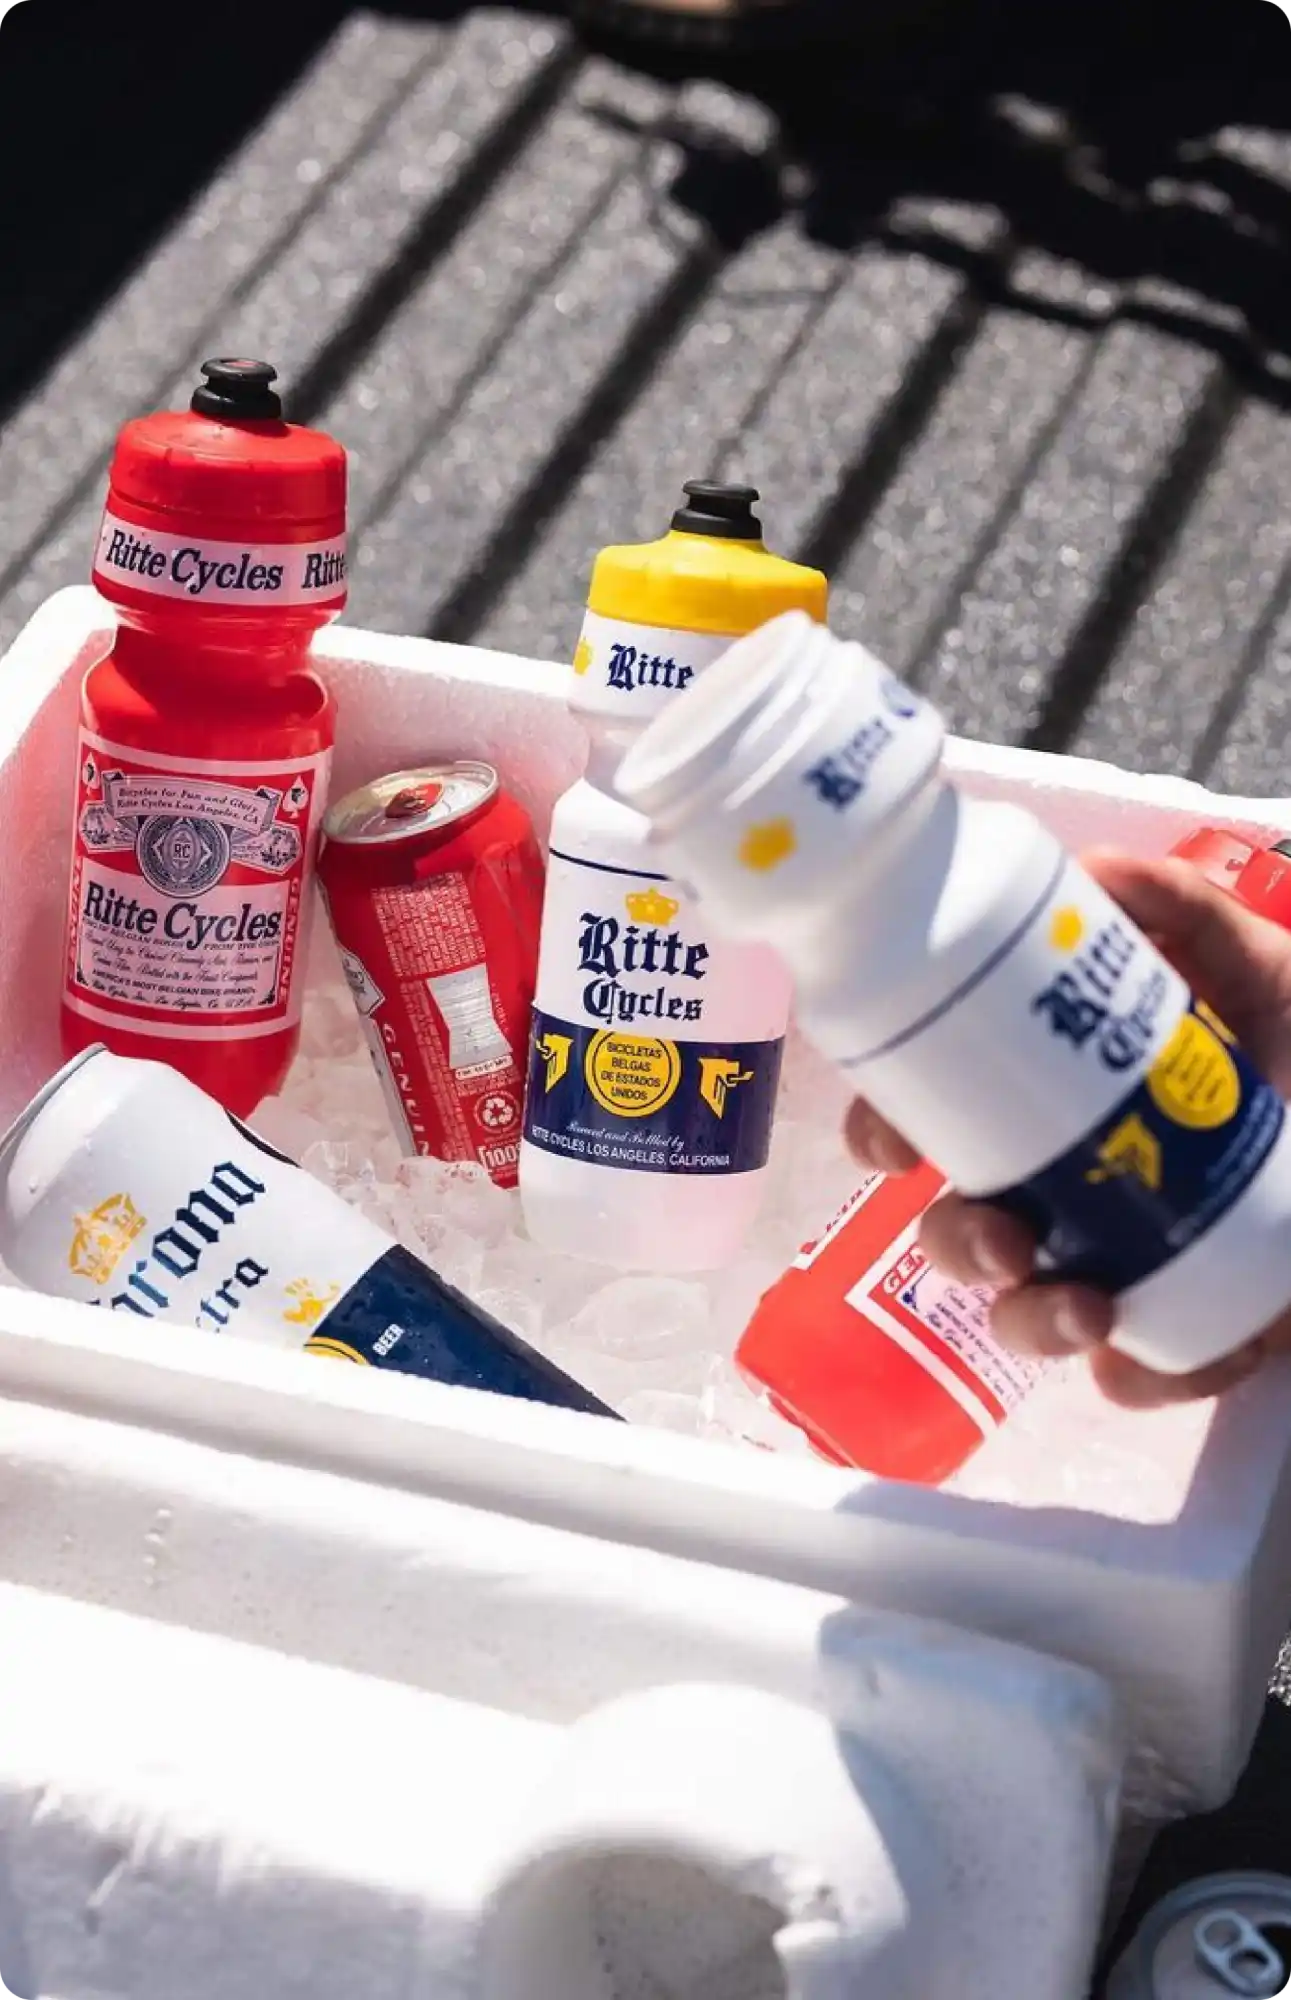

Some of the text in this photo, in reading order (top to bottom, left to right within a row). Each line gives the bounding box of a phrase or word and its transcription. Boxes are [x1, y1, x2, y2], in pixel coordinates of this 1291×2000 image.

[106, 529, 283, 594] Ritte Cycles
[607, 643, 694, 691] Ritte
[180, 789, 203, 800] Fun
[204, 794, 228, 804] and
[174, 843, 191, 858] RC
[83, 880, 158, 934] Ritte
[164, 902, 282, 950] Cycles
[577, 912, 710, 980] Ritte
[582, 978, 704, 1025] Cycles
[606, 1042, 662, 1059] BICICLETAS
[612, 1057, 652, 1072] BELGAS
[600, 1070, 661, 1087] DE ESTADOS
[611, 1086, 648, 1100] UNIDOS
[550, 1133, 585, 1153] CYCLES
[587, 1142, 610, 1157] LOS
[669, 1153, 730, 1166] CALIFORNIA
[86, 1161, 266, 1318] rona
[372, 1323, 405, 1357] BEER
